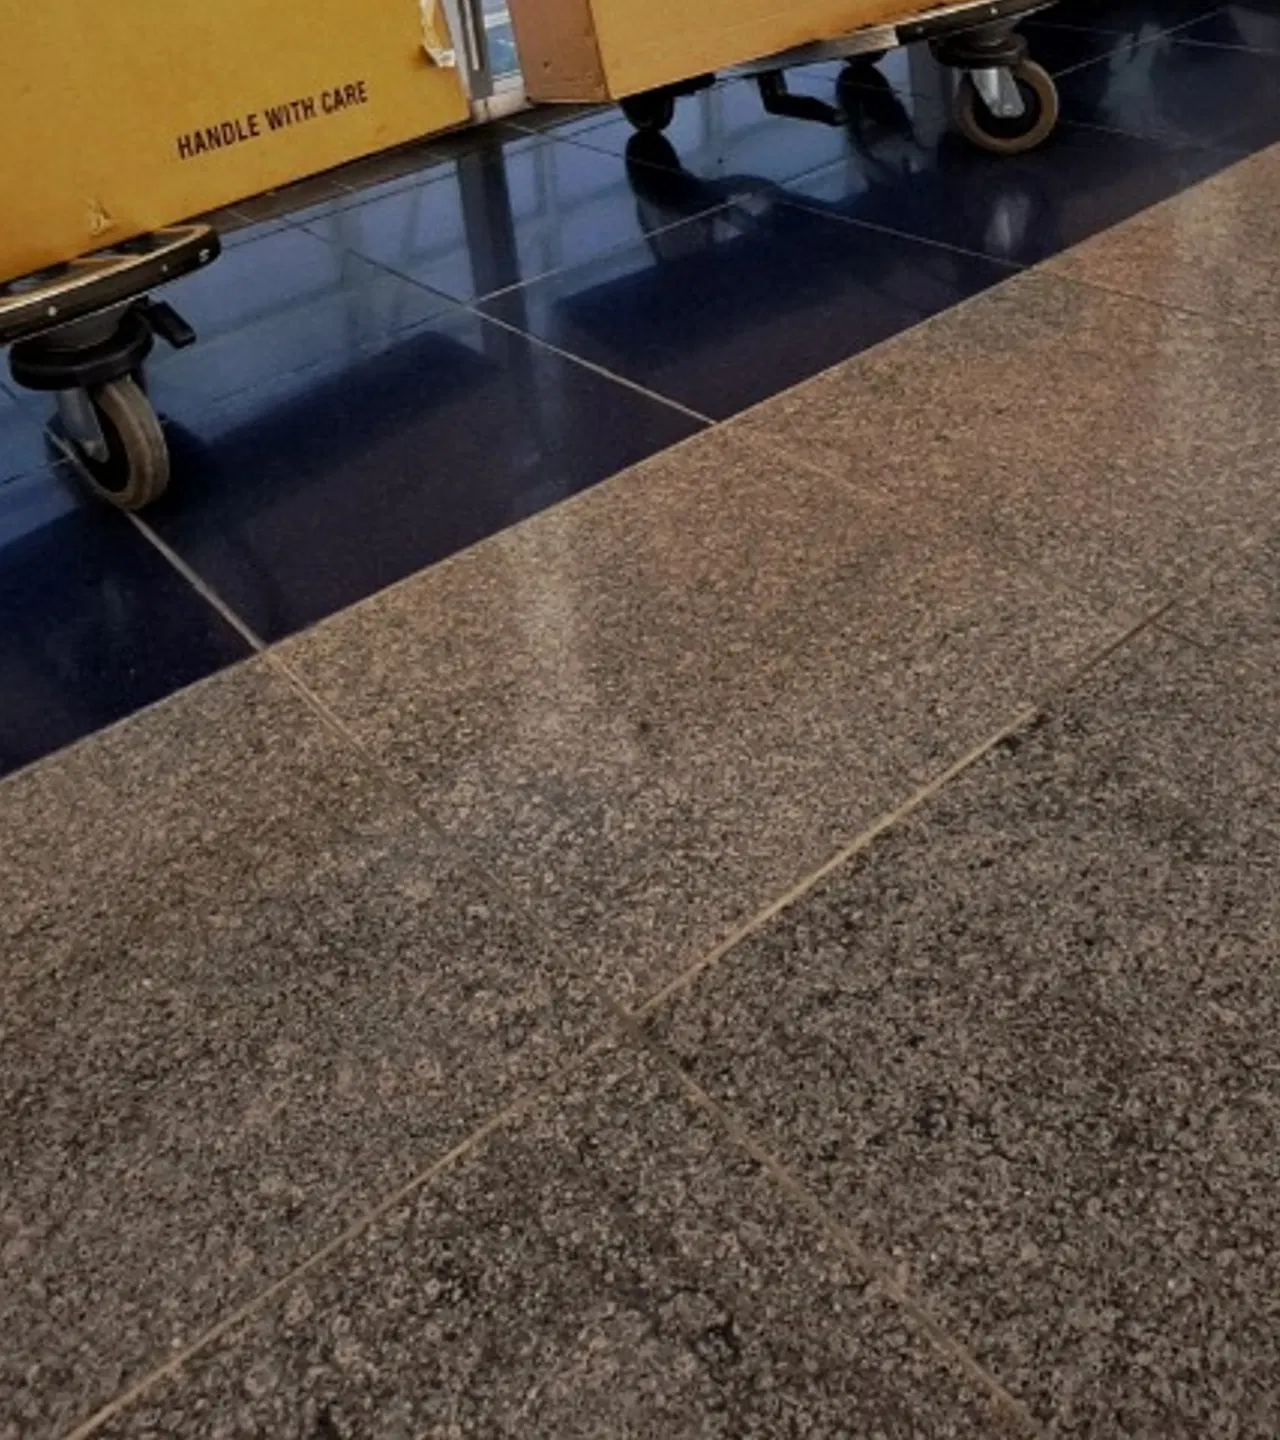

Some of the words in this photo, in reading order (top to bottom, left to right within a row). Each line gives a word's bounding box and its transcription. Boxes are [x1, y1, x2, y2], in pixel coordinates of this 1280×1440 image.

[177, 112, 261, 160] HANDLE
[264, 96, 318, 132] WITH
[321, 80, 369, 114] CARE
